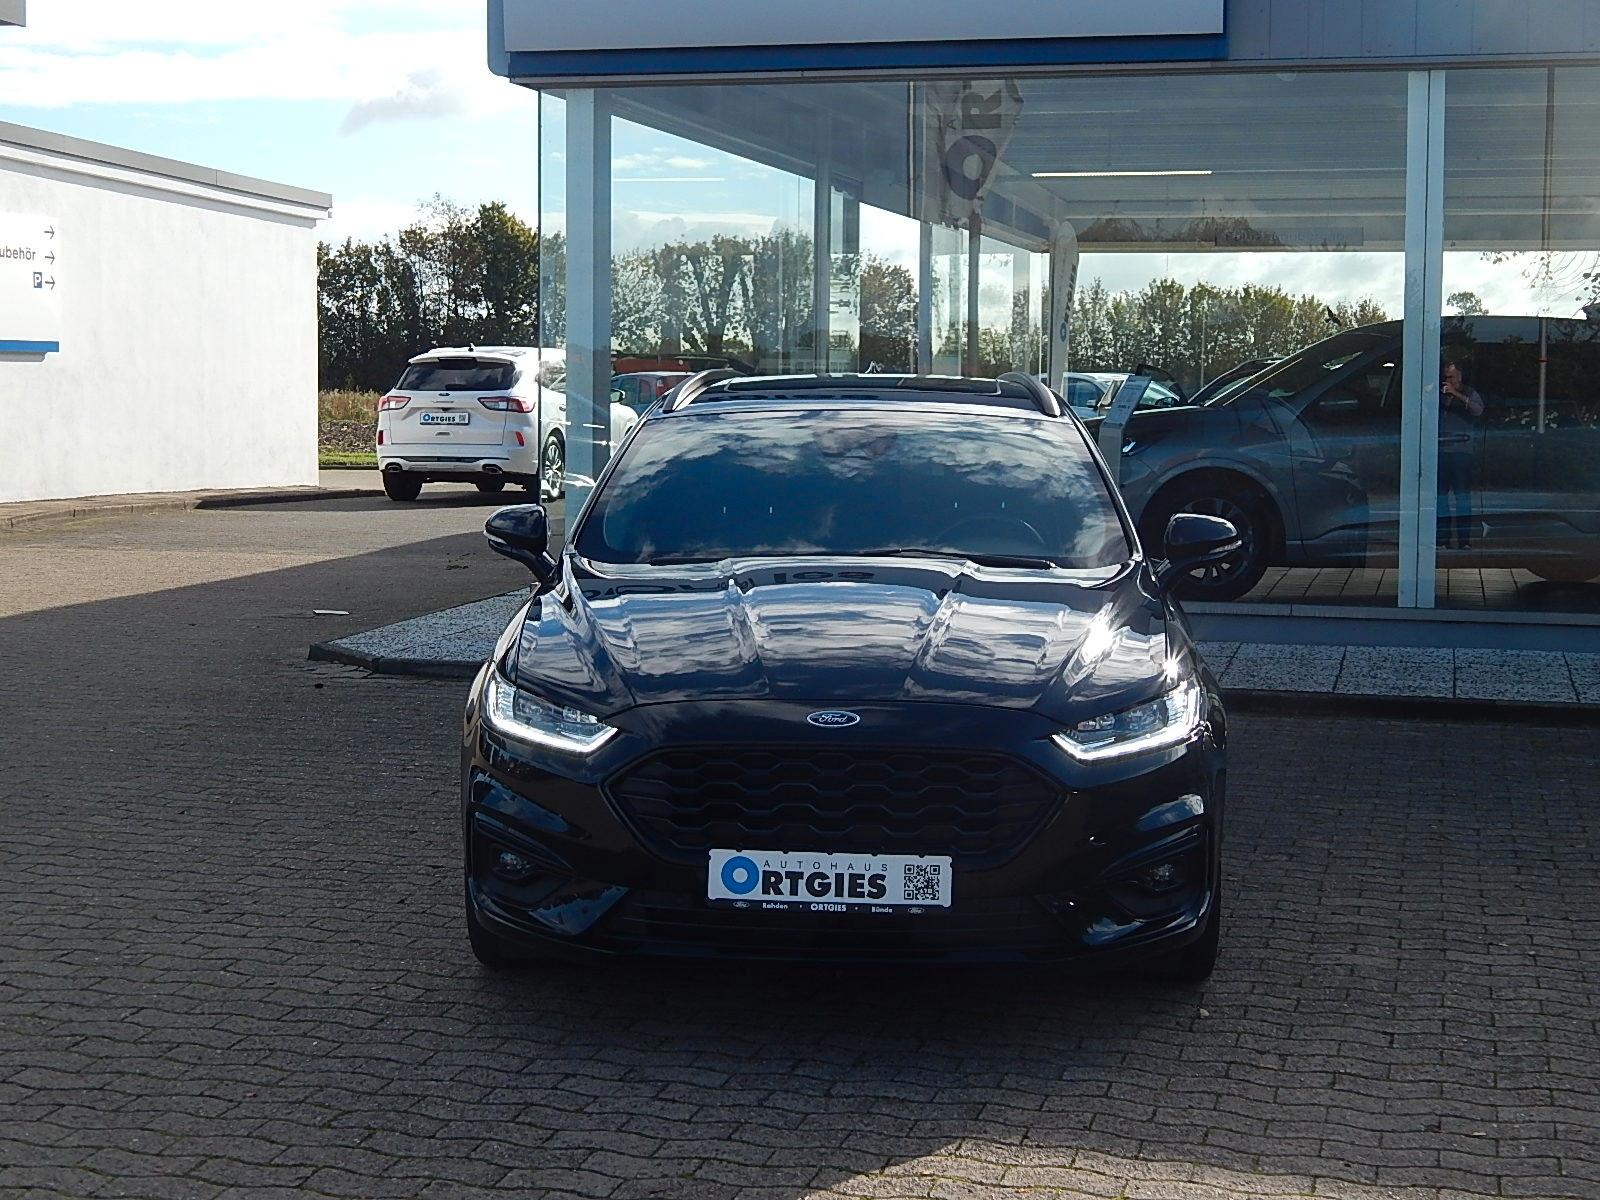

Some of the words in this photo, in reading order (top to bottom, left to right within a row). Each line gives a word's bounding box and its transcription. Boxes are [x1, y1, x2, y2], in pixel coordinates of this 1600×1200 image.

[763, 860, 888, 872] AUTOHAUS
[720, 855, 888, 899] ORTGIES
[762, 902, 788, 910] Rahden
[810, 903, 847, 912] ORTGIES
